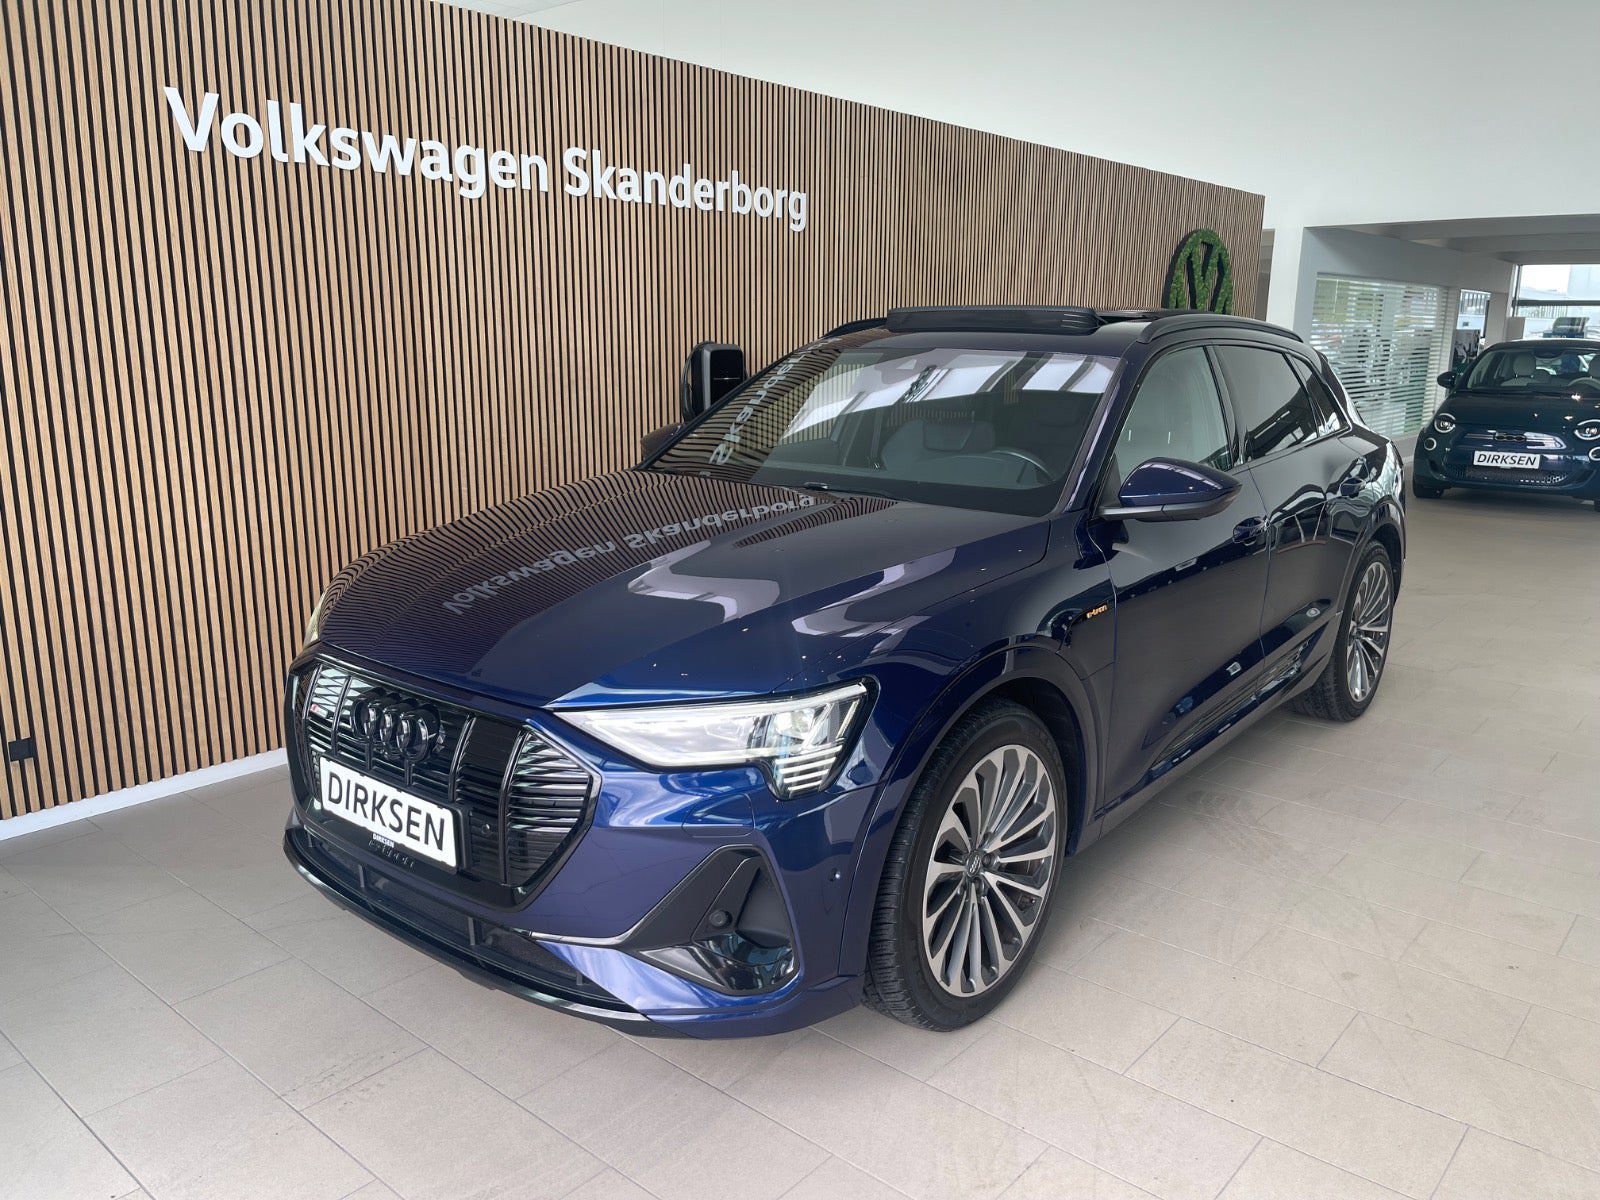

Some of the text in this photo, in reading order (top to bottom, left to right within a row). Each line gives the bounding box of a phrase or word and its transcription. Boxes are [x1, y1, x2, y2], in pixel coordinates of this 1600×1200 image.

[163, 86, 806, 232] Volkswagen Skanderborg
[1477, 453, 1537, 466] DIRKSEN
[328, 771, 445, 851] DIRKSEN
